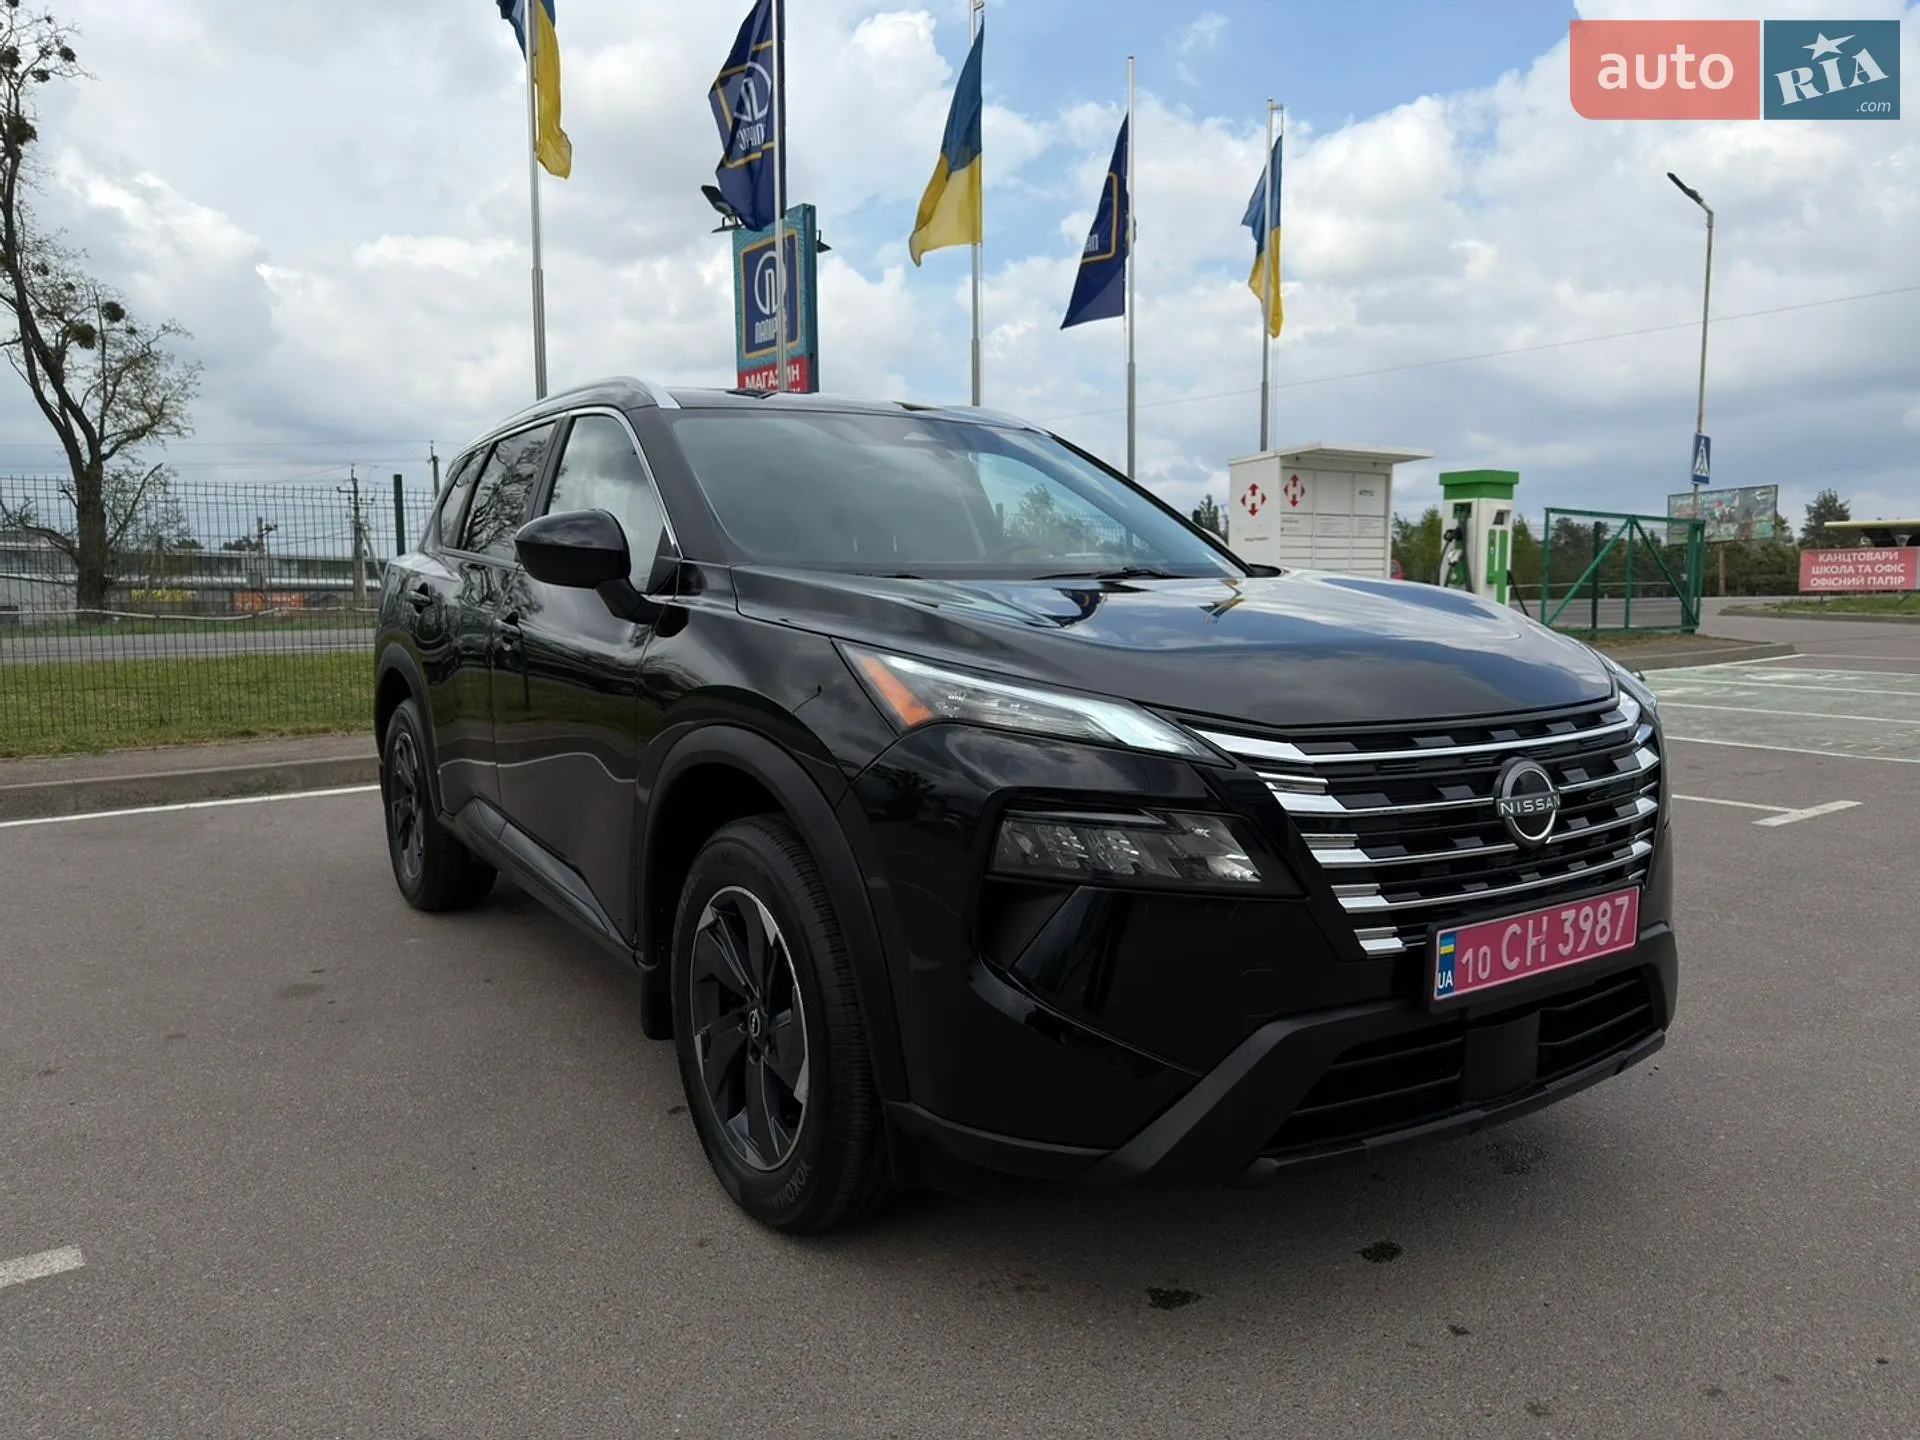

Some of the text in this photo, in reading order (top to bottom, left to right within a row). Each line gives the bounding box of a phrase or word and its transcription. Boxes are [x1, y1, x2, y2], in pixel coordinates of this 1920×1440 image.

[1818, 551, 1899, 563] КАНЦТОВАРИ
[1812, 563, 1906, 575] ШКОЛА ТА ОФІС
[1810, 574, 1906, 586] ОФІСНИЙ ПАПІР
[1501, 794, 1560, 815] NISSAN
[1461, 945, 1491, 983] 10
[1558, 896, 1629, 956] 3987
[1438, 971, 1453, 989] UA
